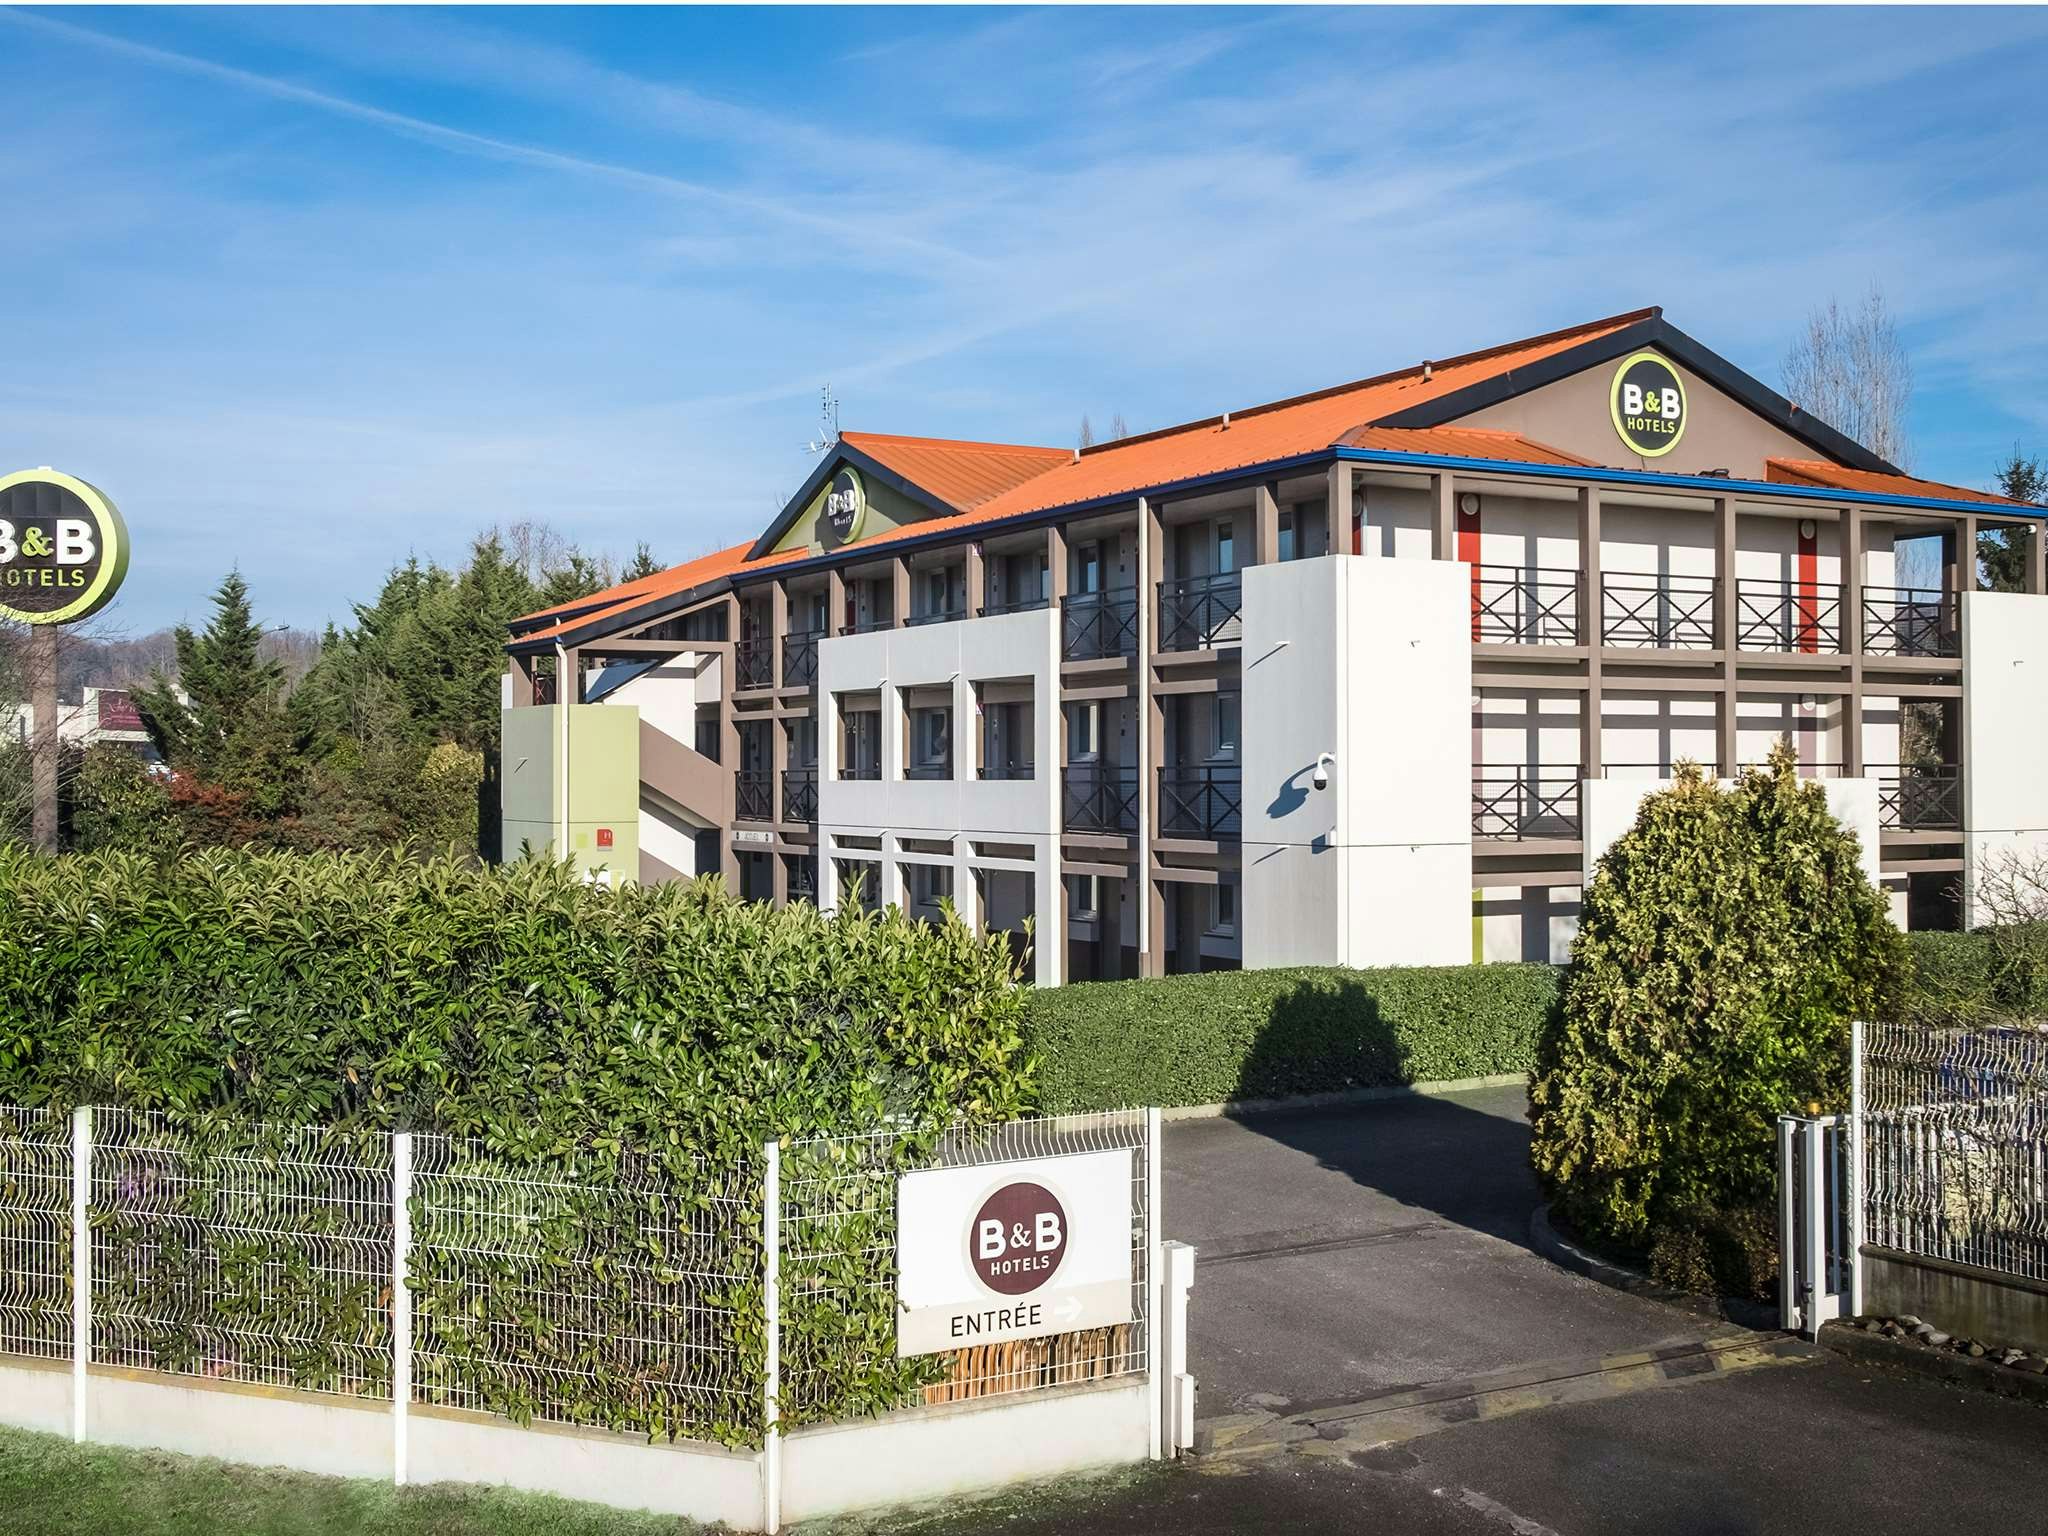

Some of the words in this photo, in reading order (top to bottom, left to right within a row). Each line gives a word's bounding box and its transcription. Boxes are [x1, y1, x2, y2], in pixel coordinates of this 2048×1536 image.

[1623, 383, 1681, 420] B&B
[1627, 416, 1675, 434] HOTELS
[0, 568, 86, 587] OTELS
[979, 1211, 1062, 1260] B&B
[990, 1255, 1050, 1276] HOTELS
[951, 1302, 1042, 1338] ENTRÉE
